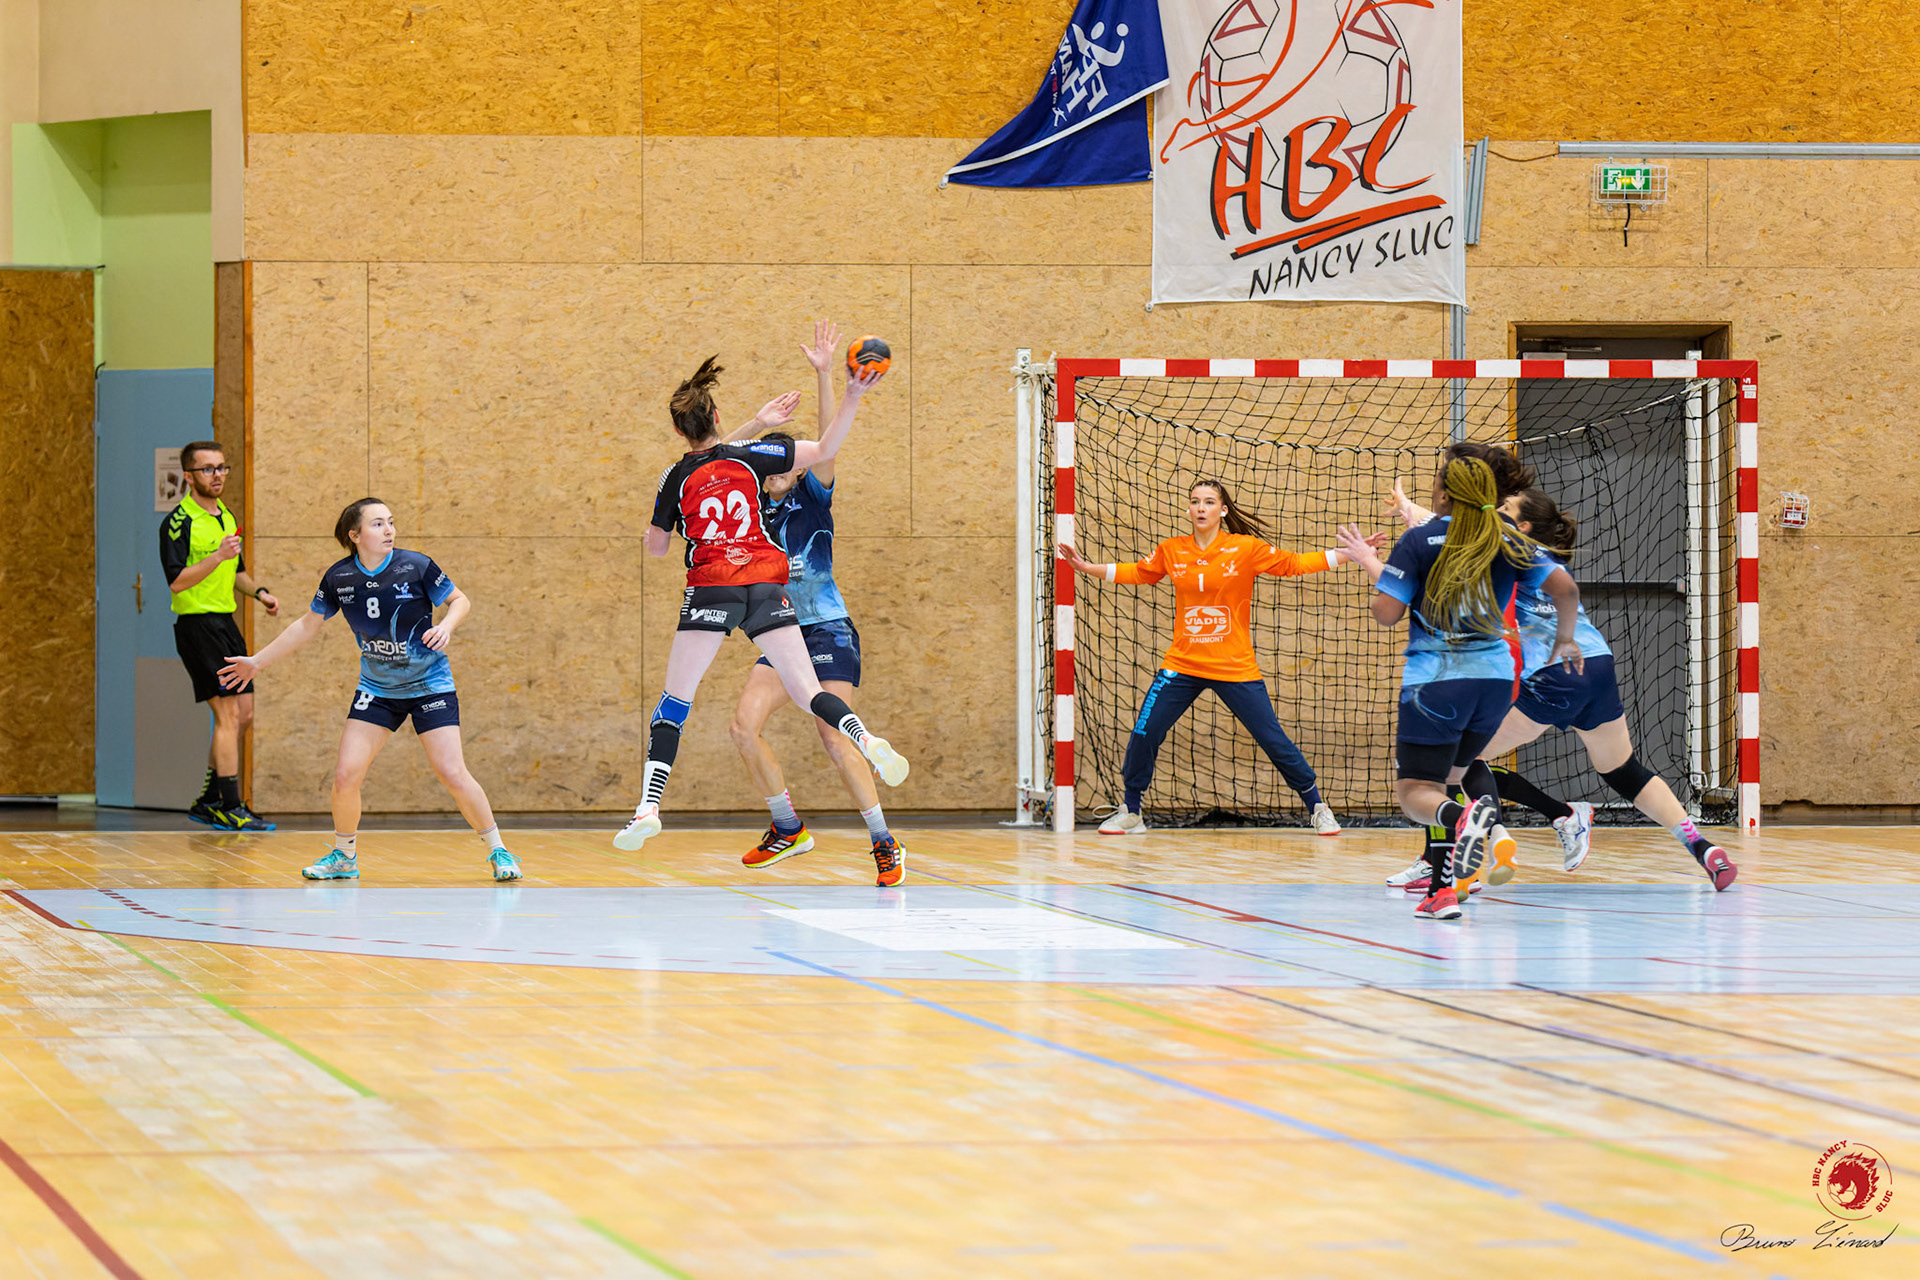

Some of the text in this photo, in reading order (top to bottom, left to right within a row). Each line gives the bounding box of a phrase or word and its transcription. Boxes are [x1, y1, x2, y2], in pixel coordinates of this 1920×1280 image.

[1210, 103, 1436, 241] HBC
[1249, 215, 1455, 300] NANCY SLUC
[1198, 573, 1204, 592] 1
[366, 596, 381, 619] 8
[704, 608, 728, 618] INTER
[703, 614, 726, 624] SPORT
[1184, 616, 1227, 625] VIADIS
[353, 691, 376, 711] 8
